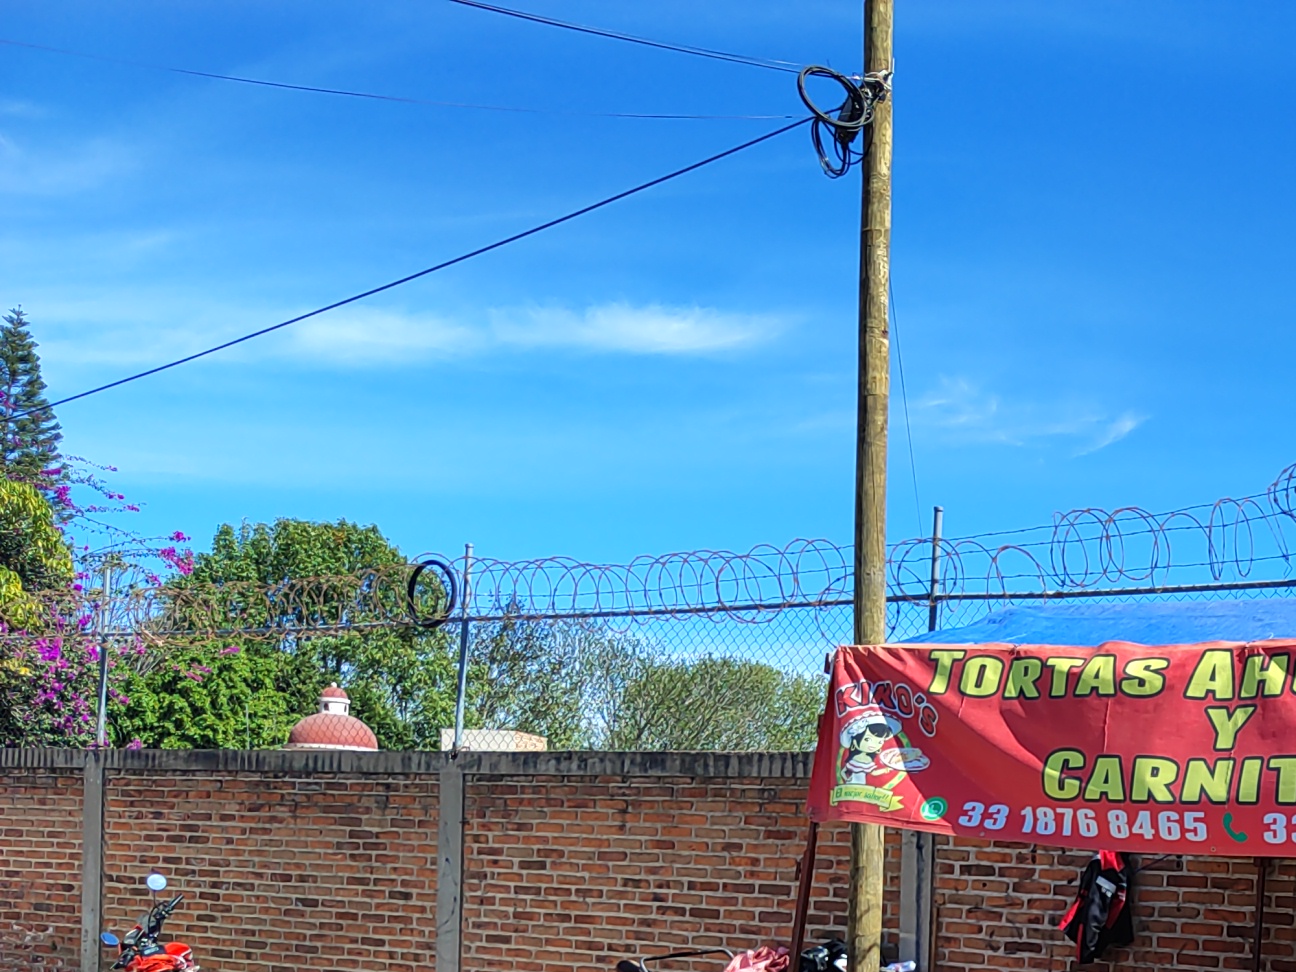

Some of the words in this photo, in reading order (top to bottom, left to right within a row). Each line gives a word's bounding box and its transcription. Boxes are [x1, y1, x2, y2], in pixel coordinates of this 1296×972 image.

[928, 650, 1169, 699] TORTAS
[1205, 704, 1257, 750] Y
[958, 801, 1009, 831] 33
[1021, 805, 1099, 838] 1876
[1107, 809, 1208, 841] 8465
